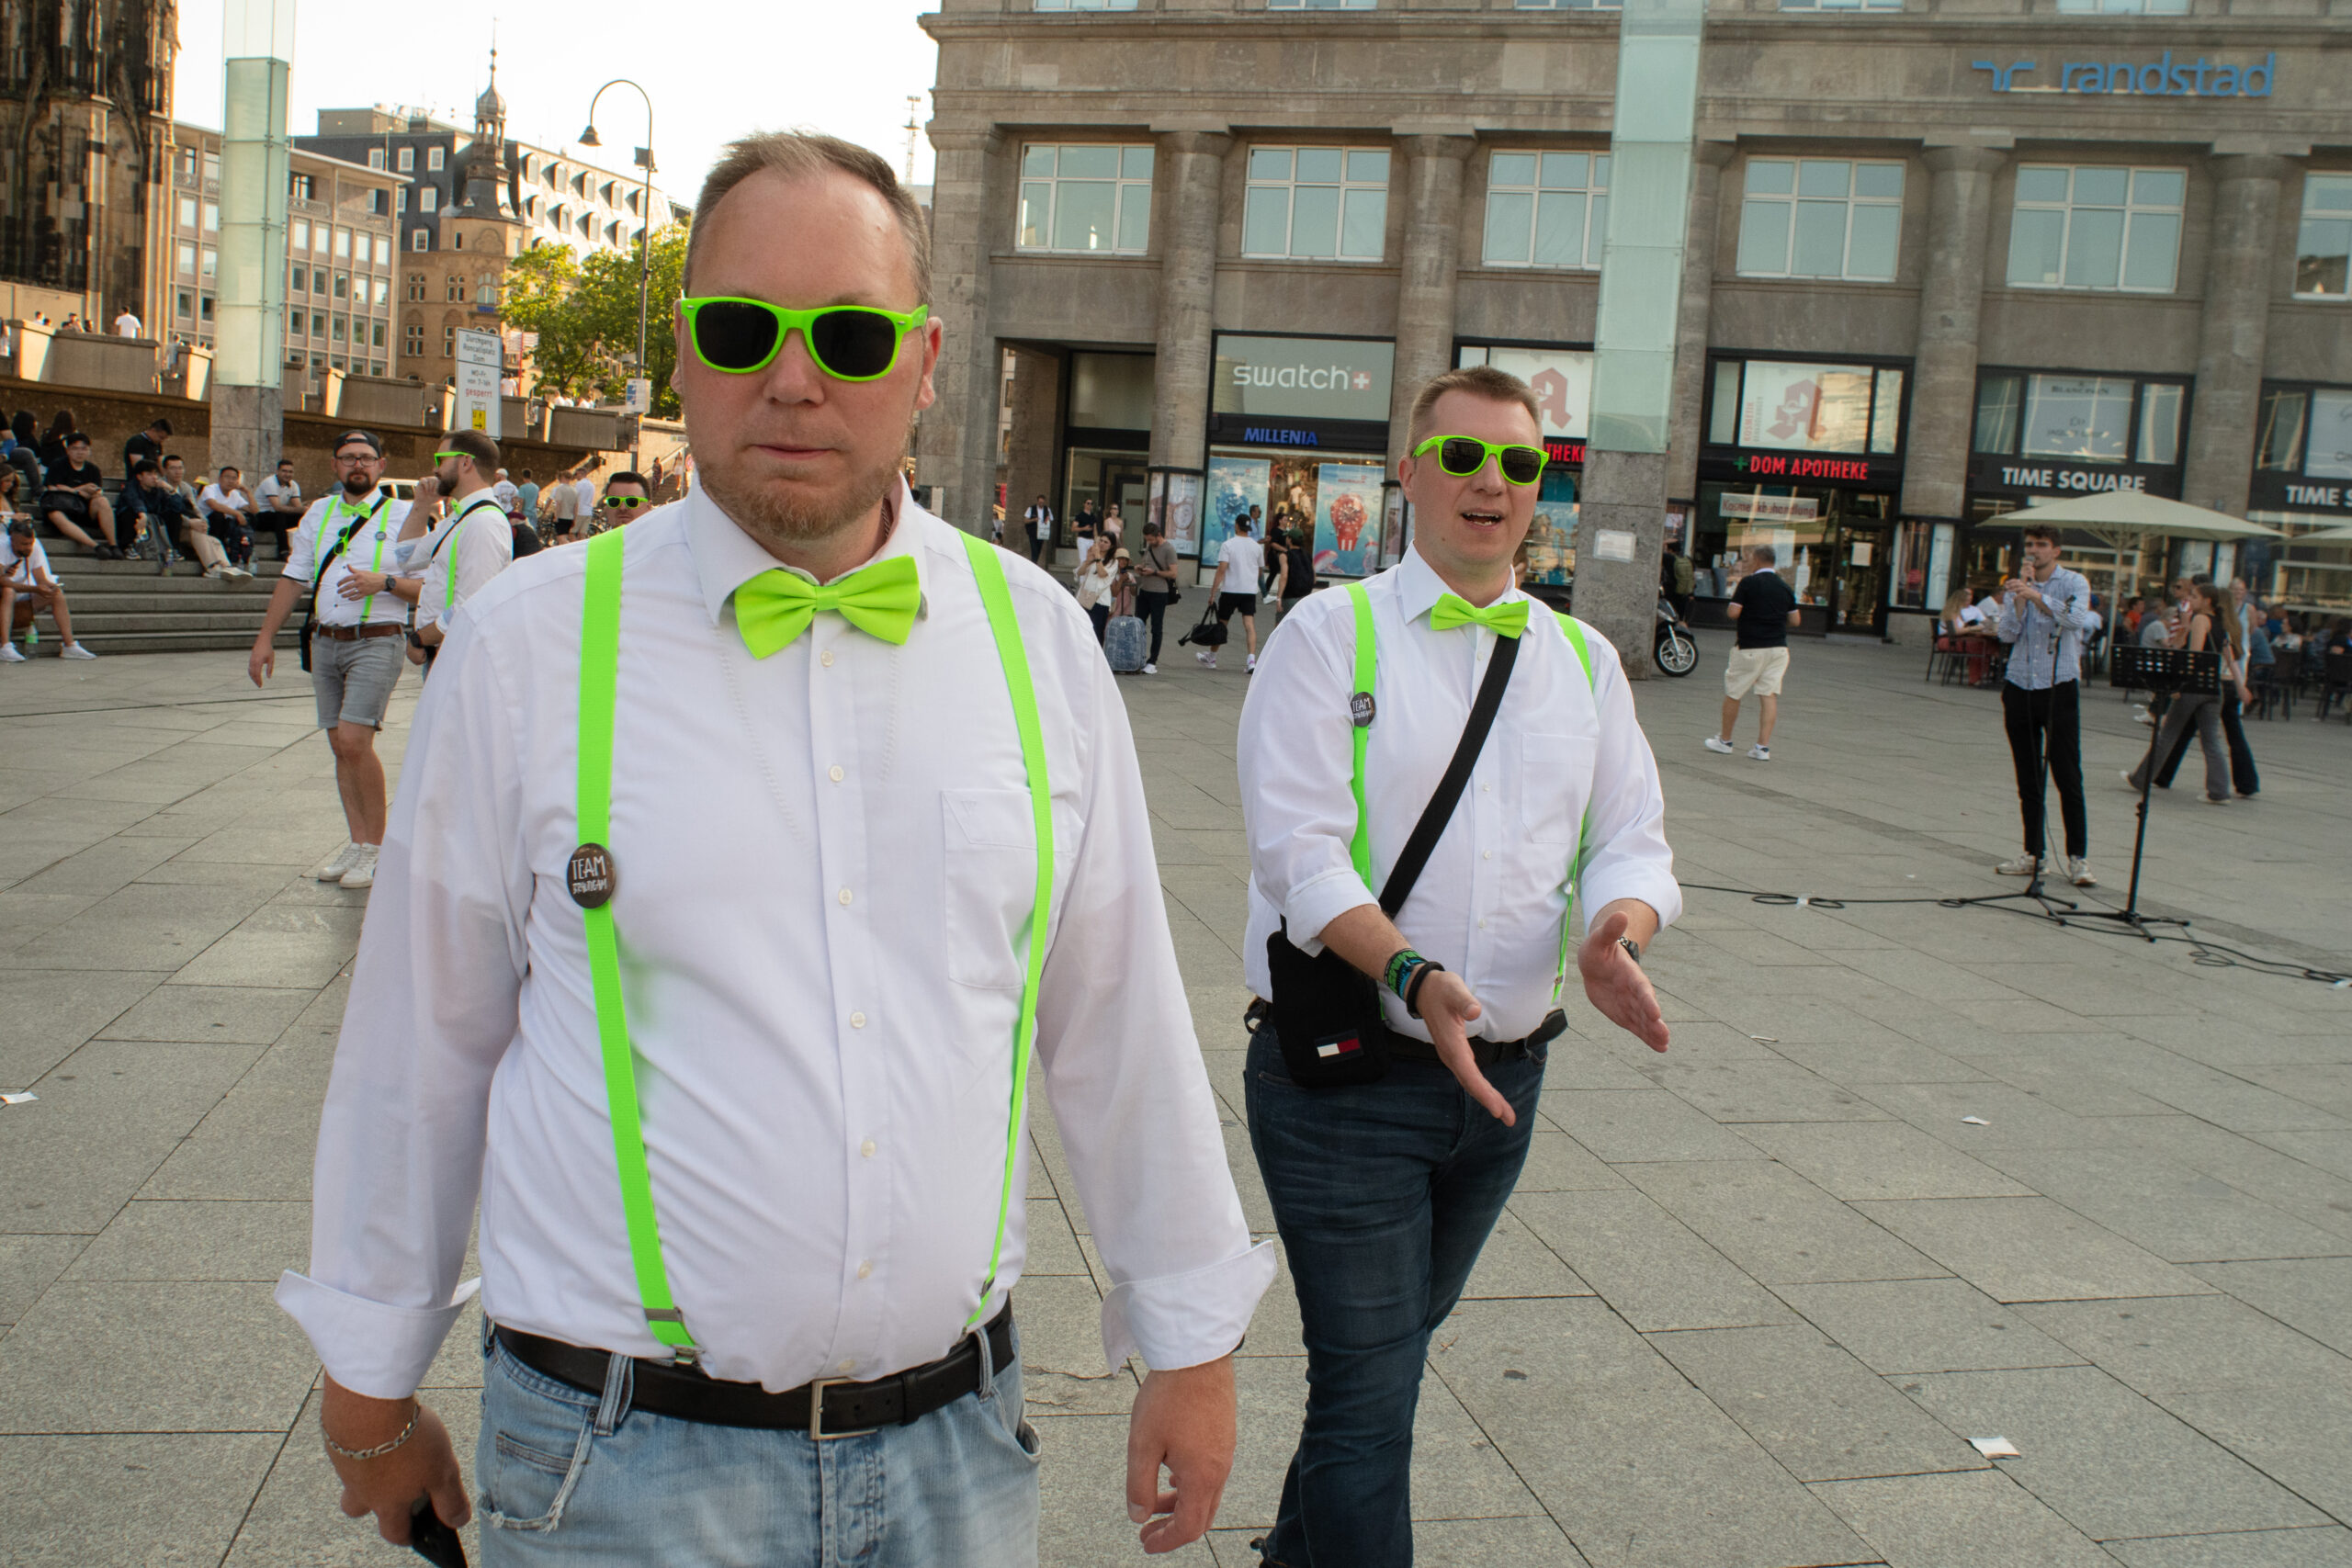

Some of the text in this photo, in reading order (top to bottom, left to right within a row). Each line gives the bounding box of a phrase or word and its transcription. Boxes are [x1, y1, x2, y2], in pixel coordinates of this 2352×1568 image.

[2062, 51, 2276, 96] randstad
[1232, 364, 1349, 390] swatch
[466, 389, 492, 398] gesperrt
[1244, 428, 1318, 446] MILLENIA
[1544, 444, 1587, 463] THEKE
[1750, 456, 1869, 480] DOM APOTHEKE
[2002, 467, 2146, 493] TIME SQUARE
[2285, 485, 2341, 506] TIME
[1352, 697, 1371, 713] TEAM
[571, 855, 606, 880] TEAM
